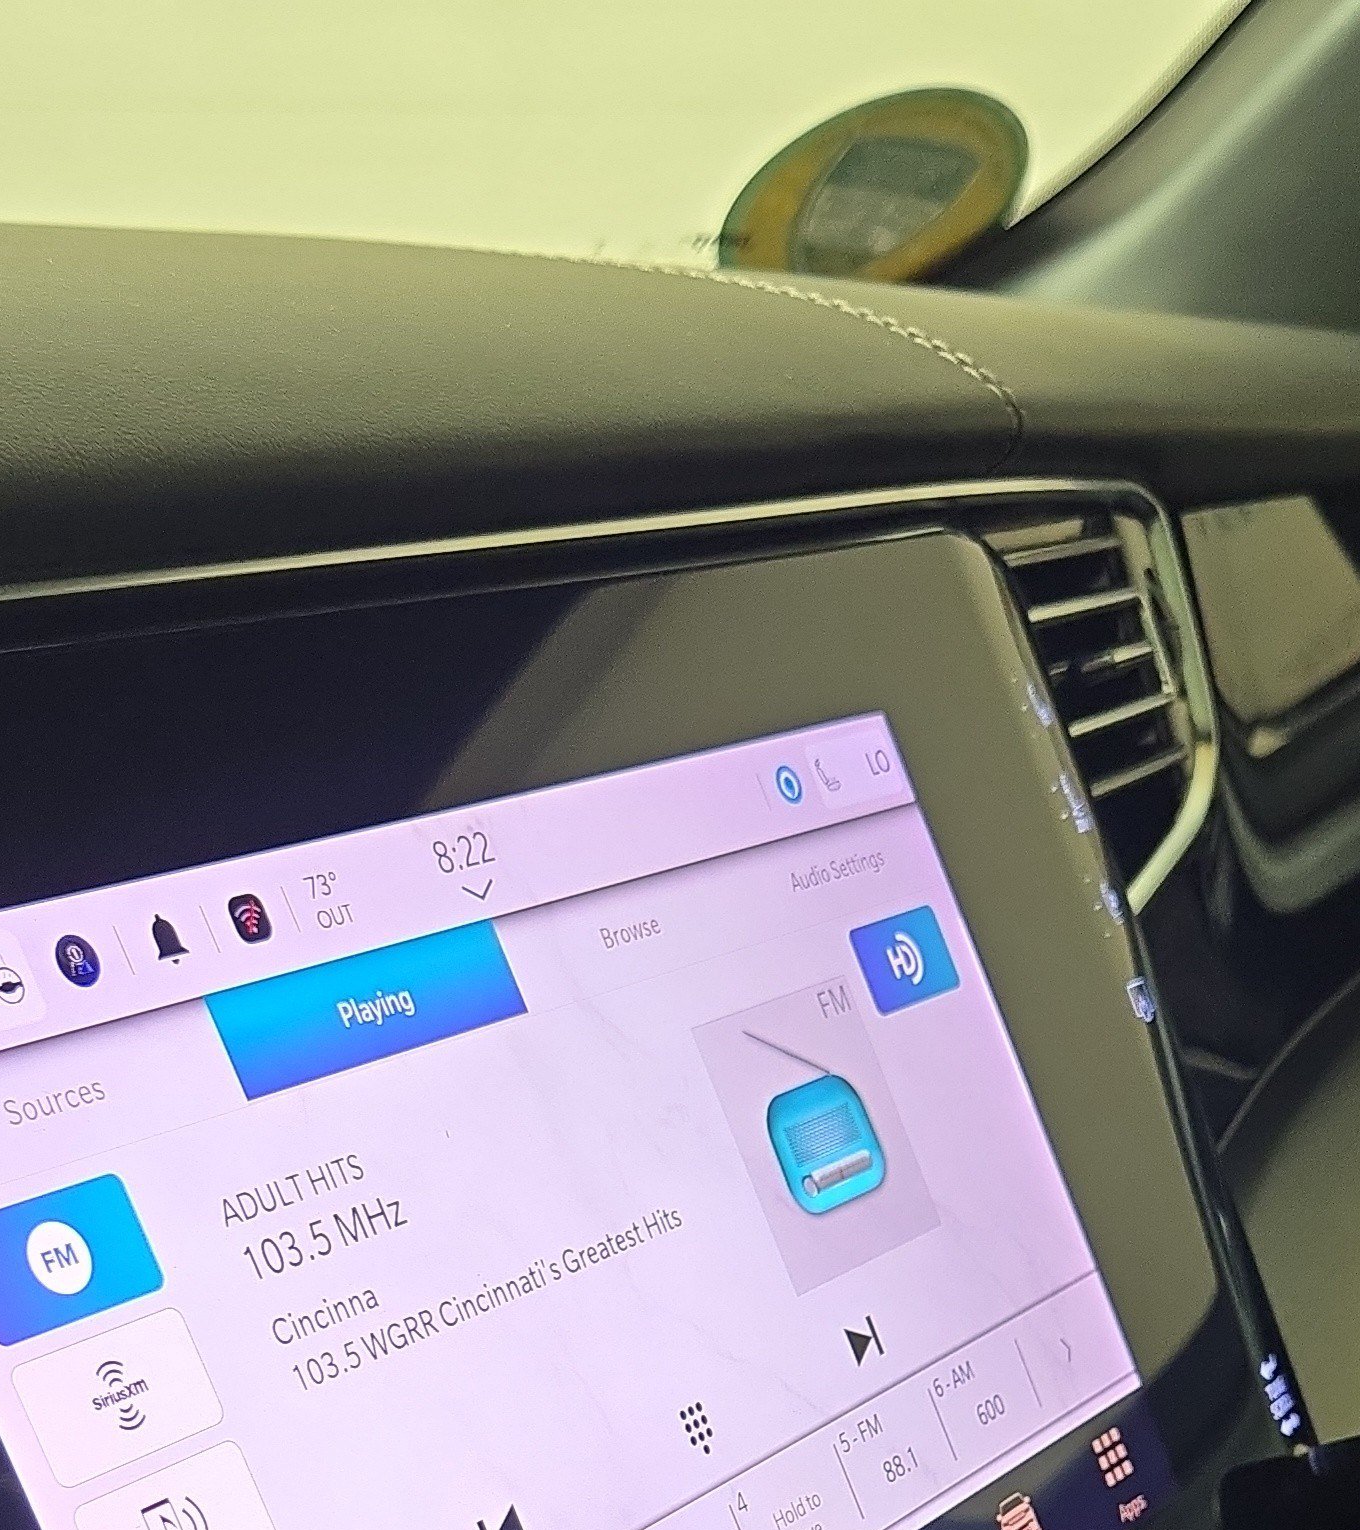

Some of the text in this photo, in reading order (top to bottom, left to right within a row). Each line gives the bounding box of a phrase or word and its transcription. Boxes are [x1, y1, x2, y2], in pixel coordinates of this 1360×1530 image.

[865, 749, 892, 778] LO
[432, 830, 497, 874] 8:22
[789, 848, 886, 895] Audio Settings
[316, 902, 356, 931] OUT
[599, 914, 662, 951] Browse
[337, 985, 417, 1031] Playing
[816, 983, 852, 1021] FM
[2, 1076, 107, 1128] Sources
[220, 1152, 366, 1229] ADULT HITS
[39, 1241, 80, 1272] FM
[242, 1195, 409, 1281] 103.5 MHz
[270, 1285, 380, 1347] Cincinna
[292, 1206, 684, 1392] 103.5 WGRR Cincinnati's Greatest Hits
[950, 1360, 976, 1389] AM
[856, 1413, 884, 1443] FM
[976, 1393, 1006, 1426] 600
[882, 1446, 919, 1484] 88.1
[736, 1491, 749, 1515] 4
[803, 1490, 822, 1517] to
